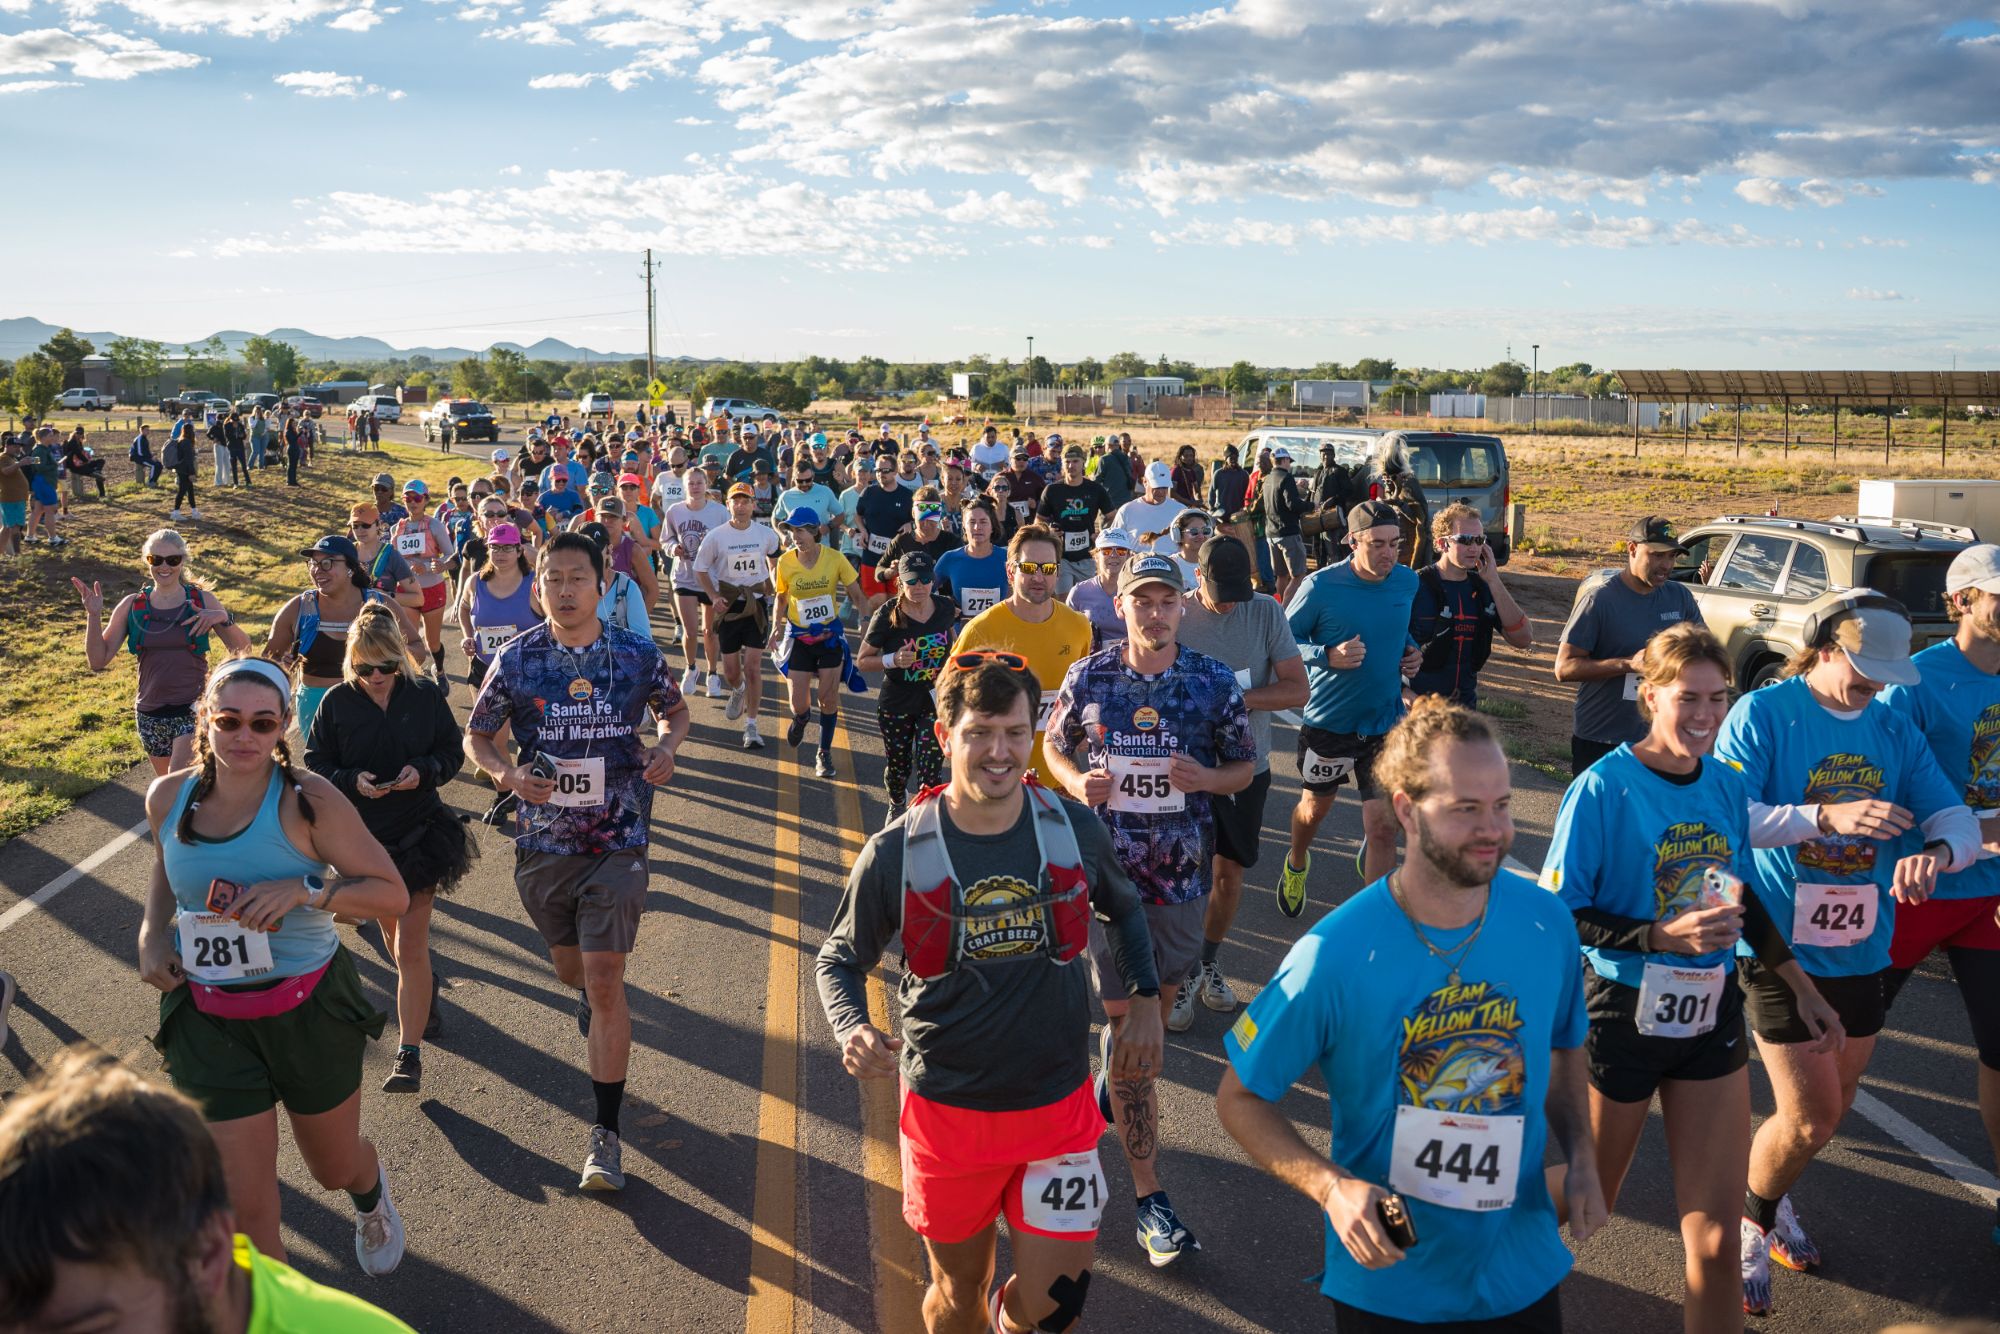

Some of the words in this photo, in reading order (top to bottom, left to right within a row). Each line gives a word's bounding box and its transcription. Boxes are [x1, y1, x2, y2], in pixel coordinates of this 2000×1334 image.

[667, 487, 682, 496] 362
[401, 539, 420, 549] 340
[871, 540, 887, 550] 446
[733, 559, 756, 571] 414
[804, 604, 828, 620] 280
[968, 598, 994, 610] 275
[903, 630, 948, 651] WORRY
[551, 702, 592, 718] Santa
[596, 701, 612, 716] Fe
[545, 711, 622, 727] International
[537, 726, 565, 741] Half
[569, 724, 631, 741] Marathon
[1112, 731, 1156, 747] Santa
[1160, 731, 1178, 748] Fe
[1827, 754, 1867, 767] TEAM
[1310, 763, 1345, 777] 497
[1119, 773, 1171, 798] 455
[1805, 769, 1854, 794] YELLOW
[1669, 822, 1705, 839] TEAM
[1654, 838, 1702, 872] YELLOW
[1810, 903, 1865, 930] 424
[968, 931, 1005, 949] CRAFT
[1007, 929, 1038, 941] BEER
[193, 935, 250, 967] 281
[1432, 981, 1488, 1011] TEAM
[1655, 993, 1711, 1024] 301
[1400, 1006, 1478, 1056] YELLOW
[1414, 1138, 1501, 1184] 444
[1040, 1173, 1099, 1211] 421
